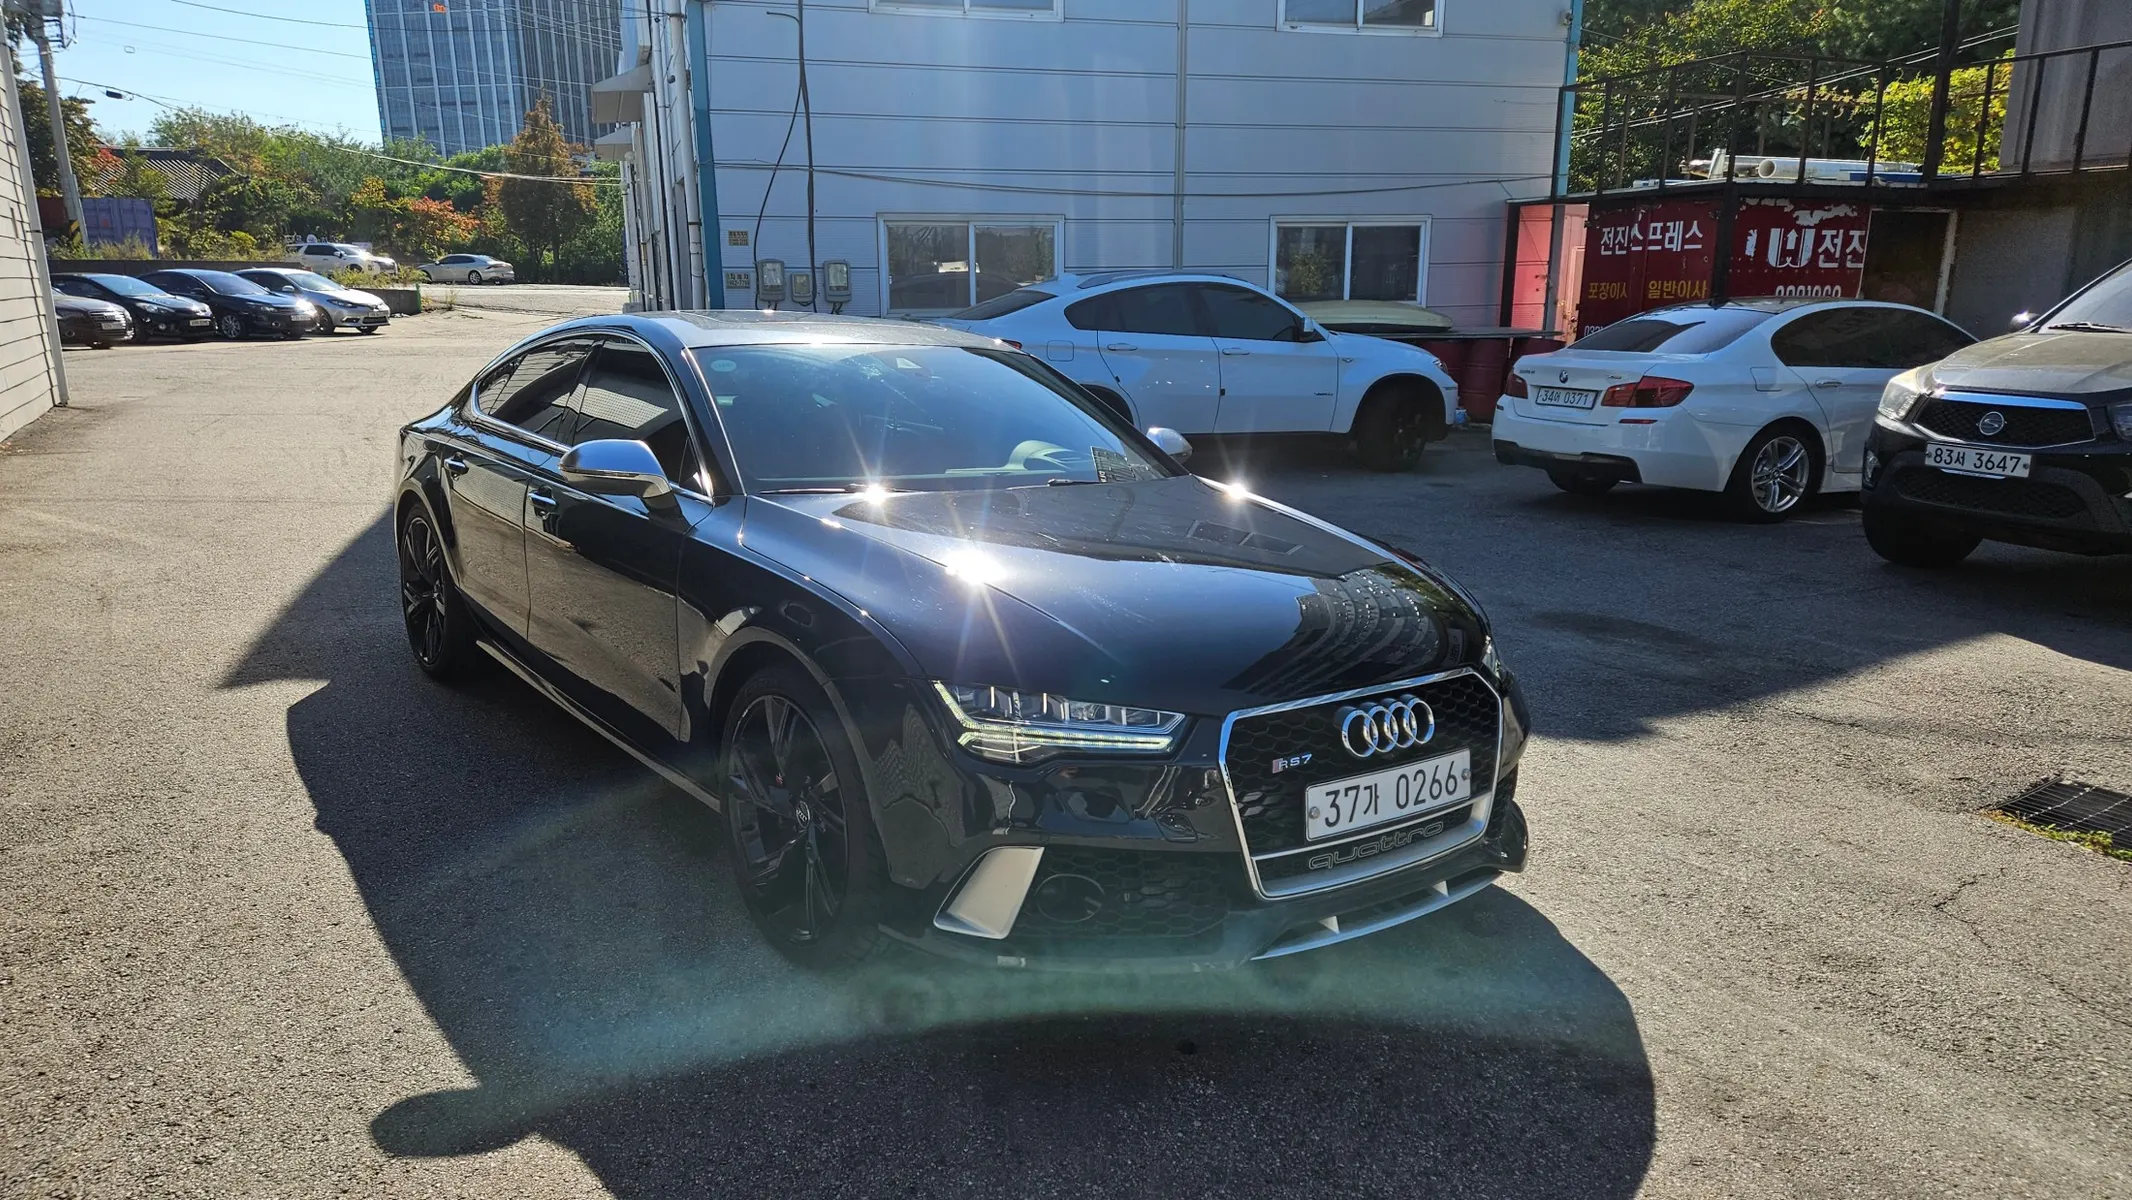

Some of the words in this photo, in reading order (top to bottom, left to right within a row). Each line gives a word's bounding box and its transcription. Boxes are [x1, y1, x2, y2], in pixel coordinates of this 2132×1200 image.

[1647, 279, 1708, 300] 일반이사
[1563, 391, 1589, 406] 0371
[1933, 447, 1966, 467] 83서
[1973, 452, 2022, 473] 3647
[1278, 753, 1313, 770] RS7
[1324, 782, 1380, 828] 37가
[1395, 760, 1458, 810] 0266
[1308, 821, 1444, 870] quattro
